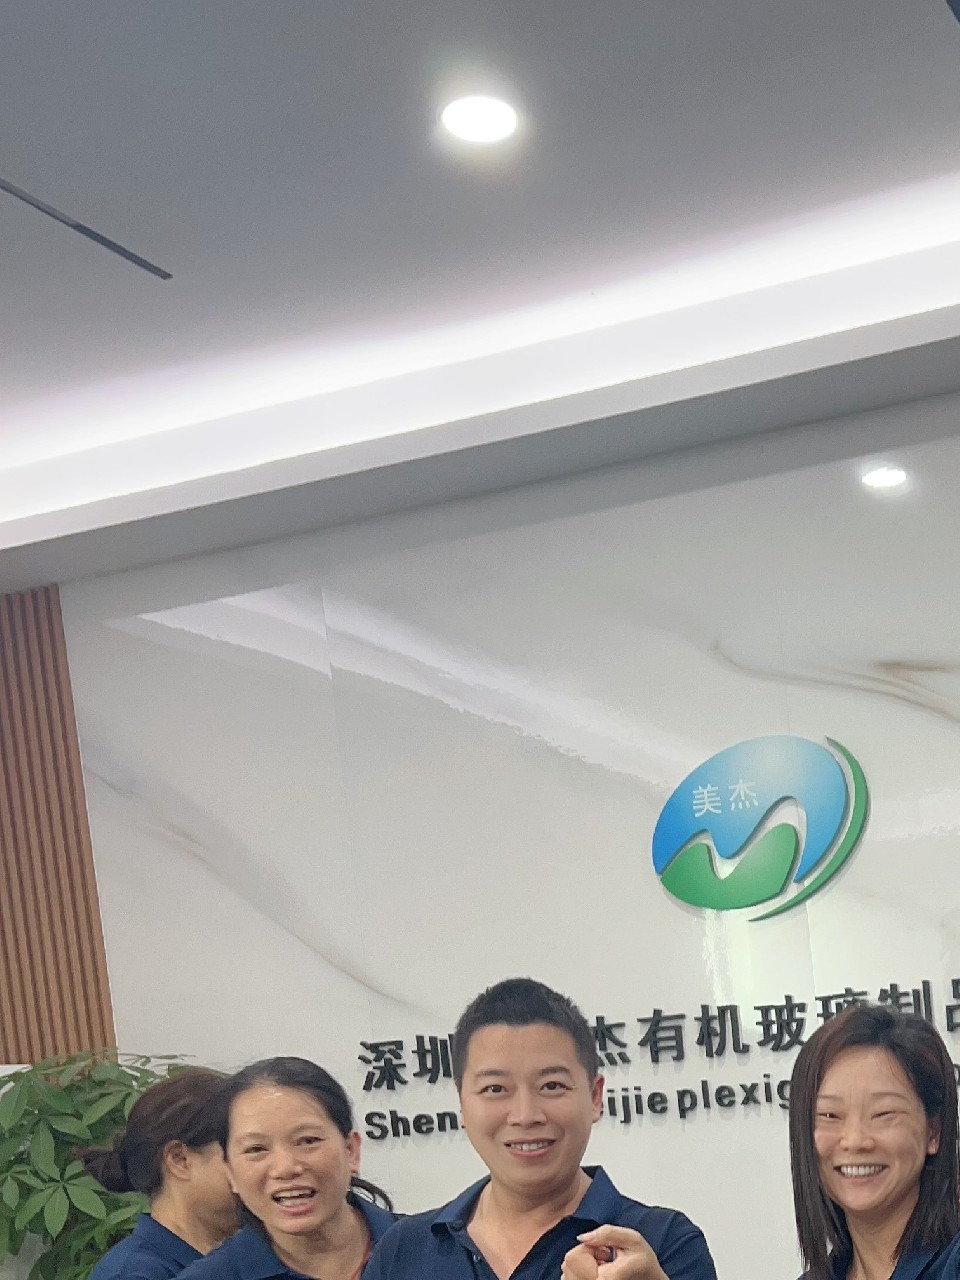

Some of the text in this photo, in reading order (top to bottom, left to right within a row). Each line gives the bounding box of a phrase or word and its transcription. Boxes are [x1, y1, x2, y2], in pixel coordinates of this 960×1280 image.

[692, 779, 759, 818] 美杰
[365, 1109, 465, 1140] Shen
[600, 1086, 668, 1123] ijie
[678, 1073, 792, 1119] plexig
